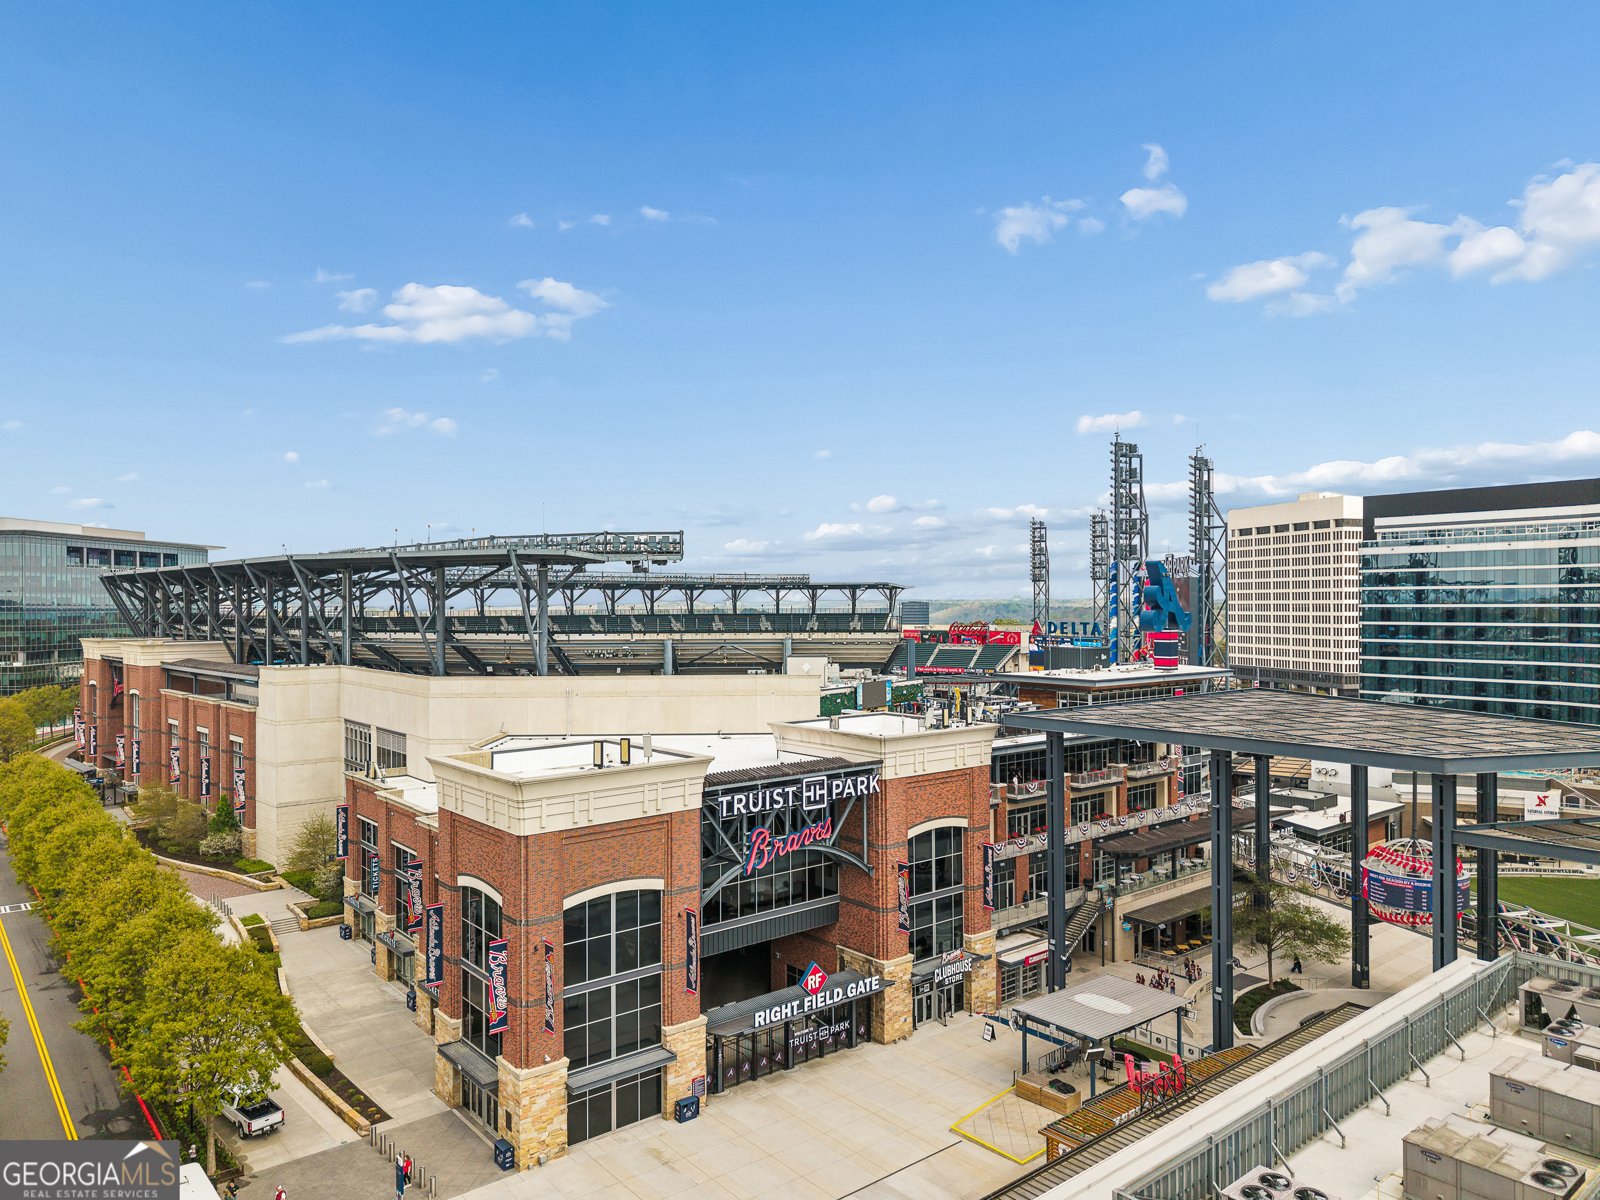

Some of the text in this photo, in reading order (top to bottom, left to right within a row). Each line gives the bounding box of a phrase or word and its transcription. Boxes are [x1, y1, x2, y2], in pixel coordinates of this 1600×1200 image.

[1047, 621, 1103, 636] DELTA
[718, 774, 881, 818] TRUIST PARK
[744, 816, 833, 877] Braves
[489, 950, 508, 1010] Braves
[807, 972, 824, 991] RF
[934, 958, 973, 983] CLUBHOUSE
[944, 973, 963, 985] STORE
[754, 975, 880, 1028] RIGHT FIELD GATE
[789, 1020, 850, 1048] TRUIST PARK
